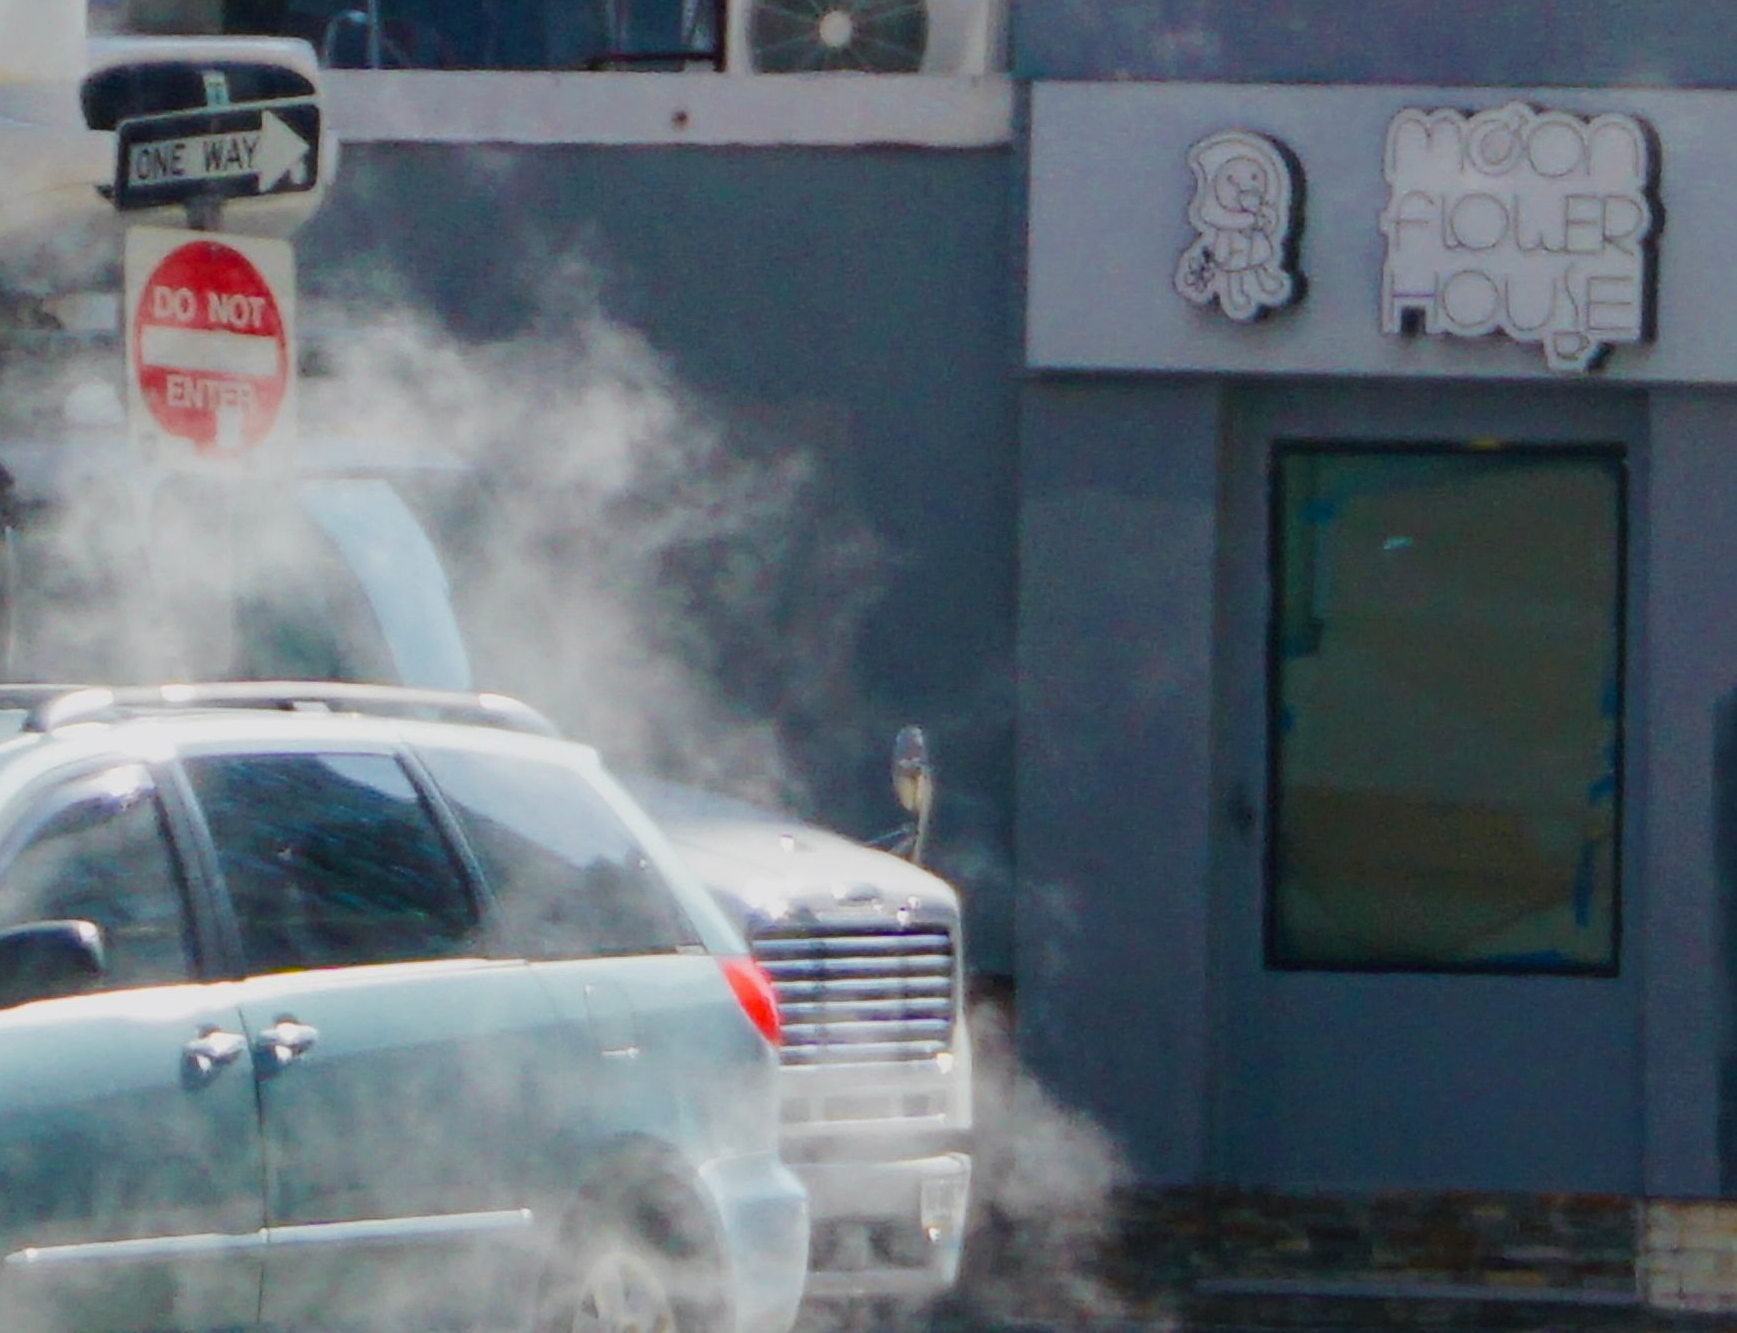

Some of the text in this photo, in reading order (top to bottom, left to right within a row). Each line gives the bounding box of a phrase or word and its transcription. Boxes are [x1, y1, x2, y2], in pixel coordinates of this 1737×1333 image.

[137, 135, 260, 180] ONE WAY
[153, 285, 267, 329] DO NOT
[1391, 264, 1634, 360] HOUSE
[166, 374, 256, 413] ENTER
